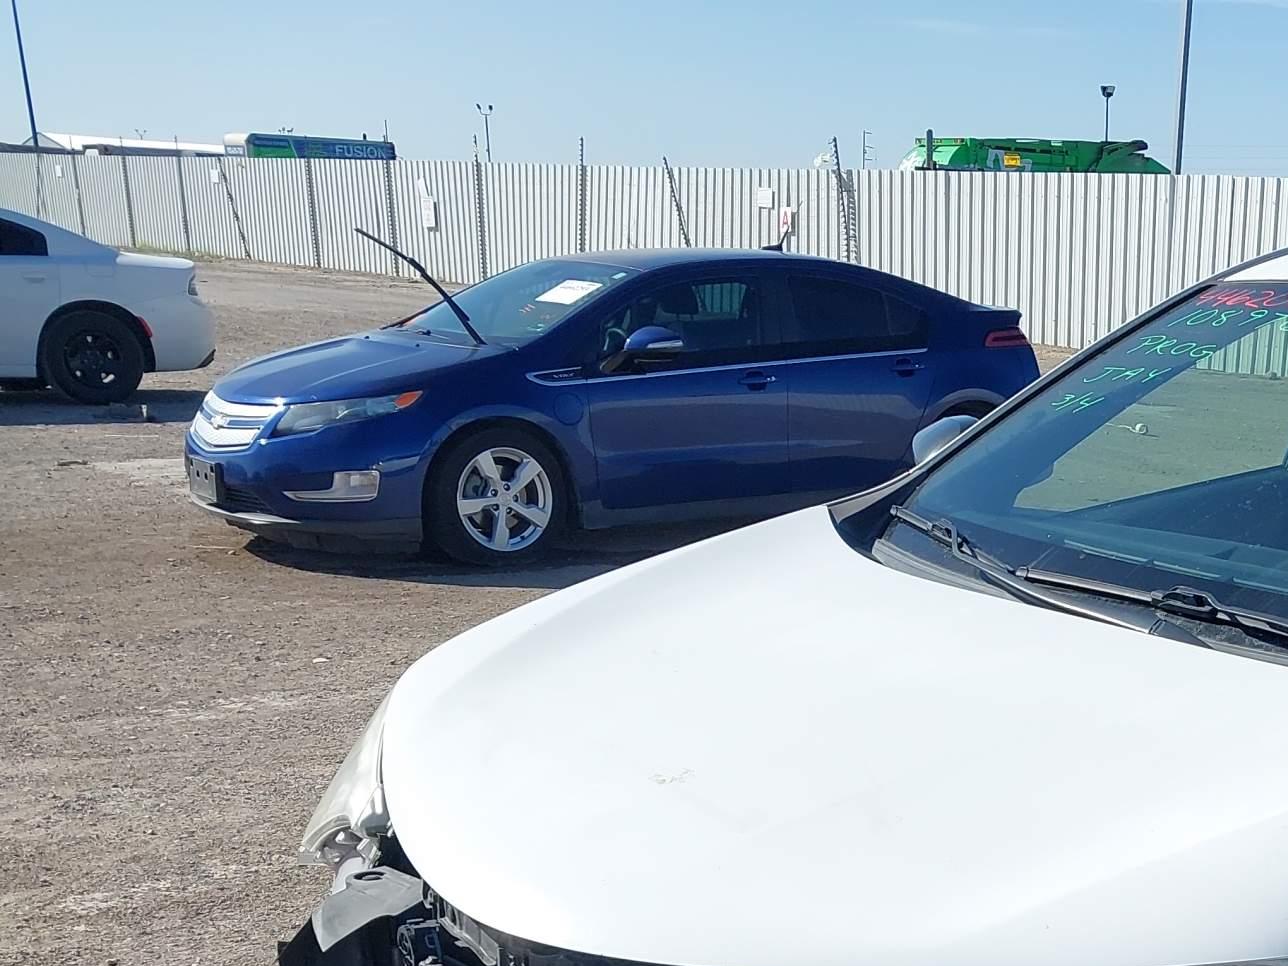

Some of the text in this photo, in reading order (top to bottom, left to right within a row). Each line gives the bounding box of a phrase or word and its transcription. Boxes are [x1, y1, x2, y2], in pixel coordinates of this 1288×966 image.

[334, 144, 386, 159] FUSION
[781, 210, 790, 229] A
[1127, 335, 1217, 363] PROG
[1052, 391, 1104, 413] 3/4
